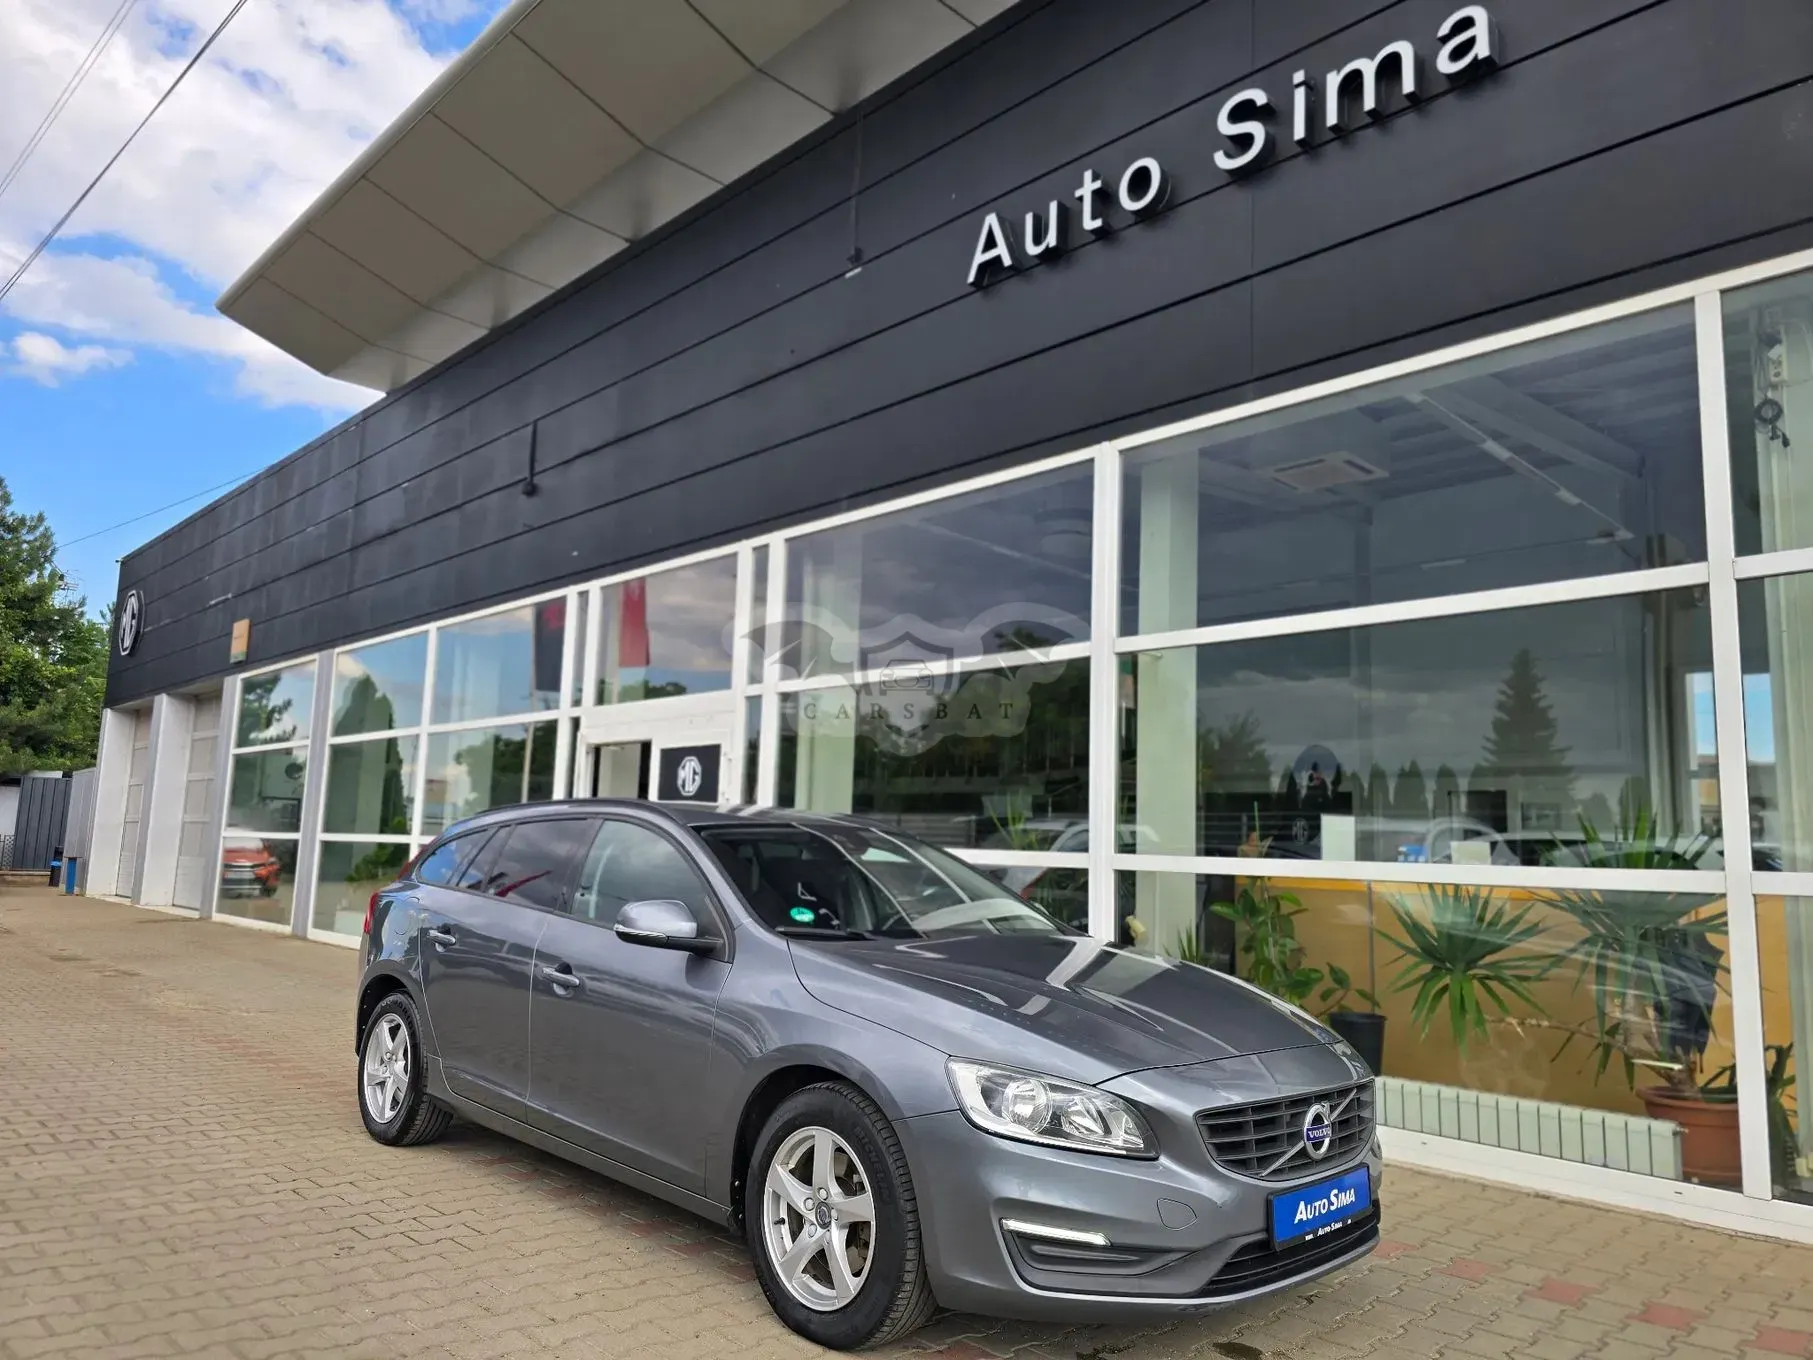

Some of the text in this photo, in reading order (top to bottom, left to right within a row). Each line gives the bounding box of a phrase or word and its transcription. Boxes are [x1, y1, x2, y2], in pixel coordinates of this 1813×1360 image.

[966, 4, 1493, 288] Auto Sima
[119, 591, 138, 653] MG
[678, 758, 701, 795] MG
[1294, 1188, 1356, 1225] AUTO SIMA
